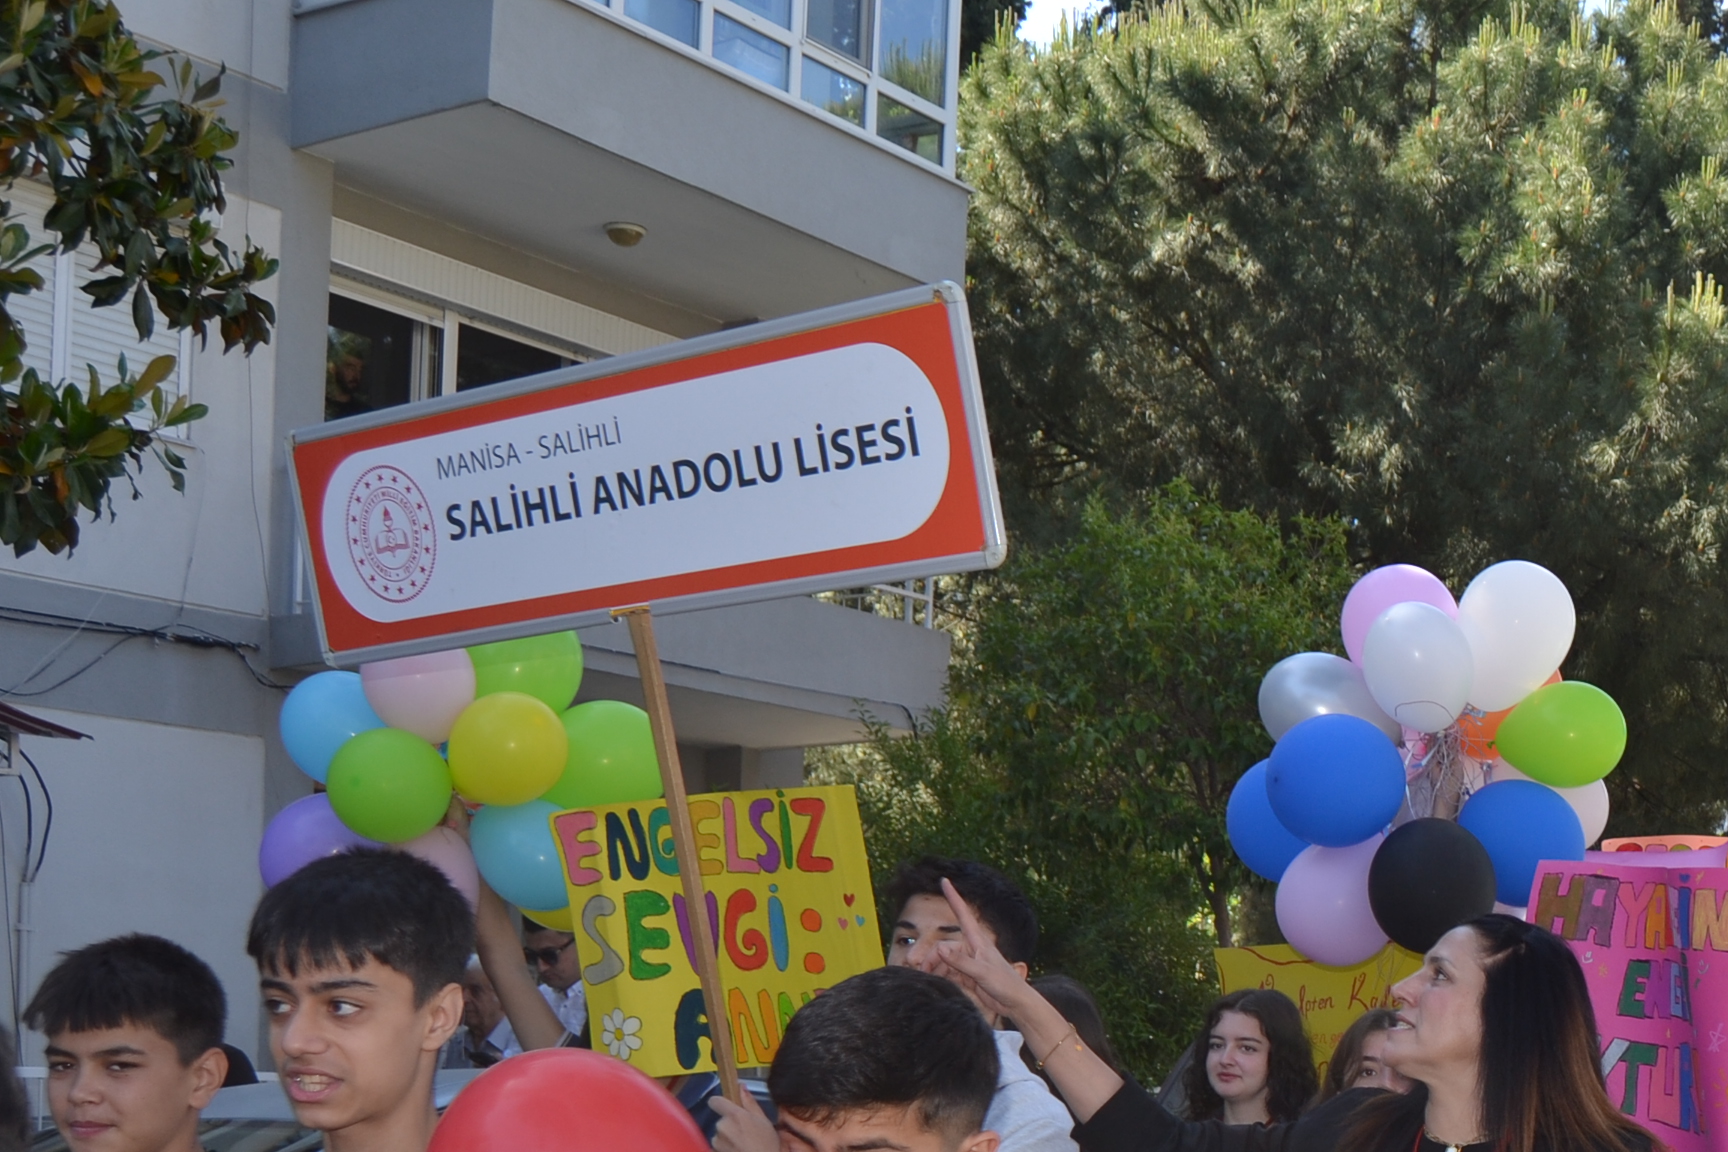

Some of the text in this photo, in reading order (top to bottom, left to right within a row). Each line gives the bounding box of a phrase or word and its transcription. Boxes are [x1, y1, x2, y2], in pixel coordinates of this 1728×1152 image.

[436, 439, 520, 480] MANİSA
[538, 415, 622, 459] SALİHLİ
[446, 406, 921, 541] SALİHLİ ANADOLU LİSESİ
[554, 789, 834, 886] ENGELSİZ
